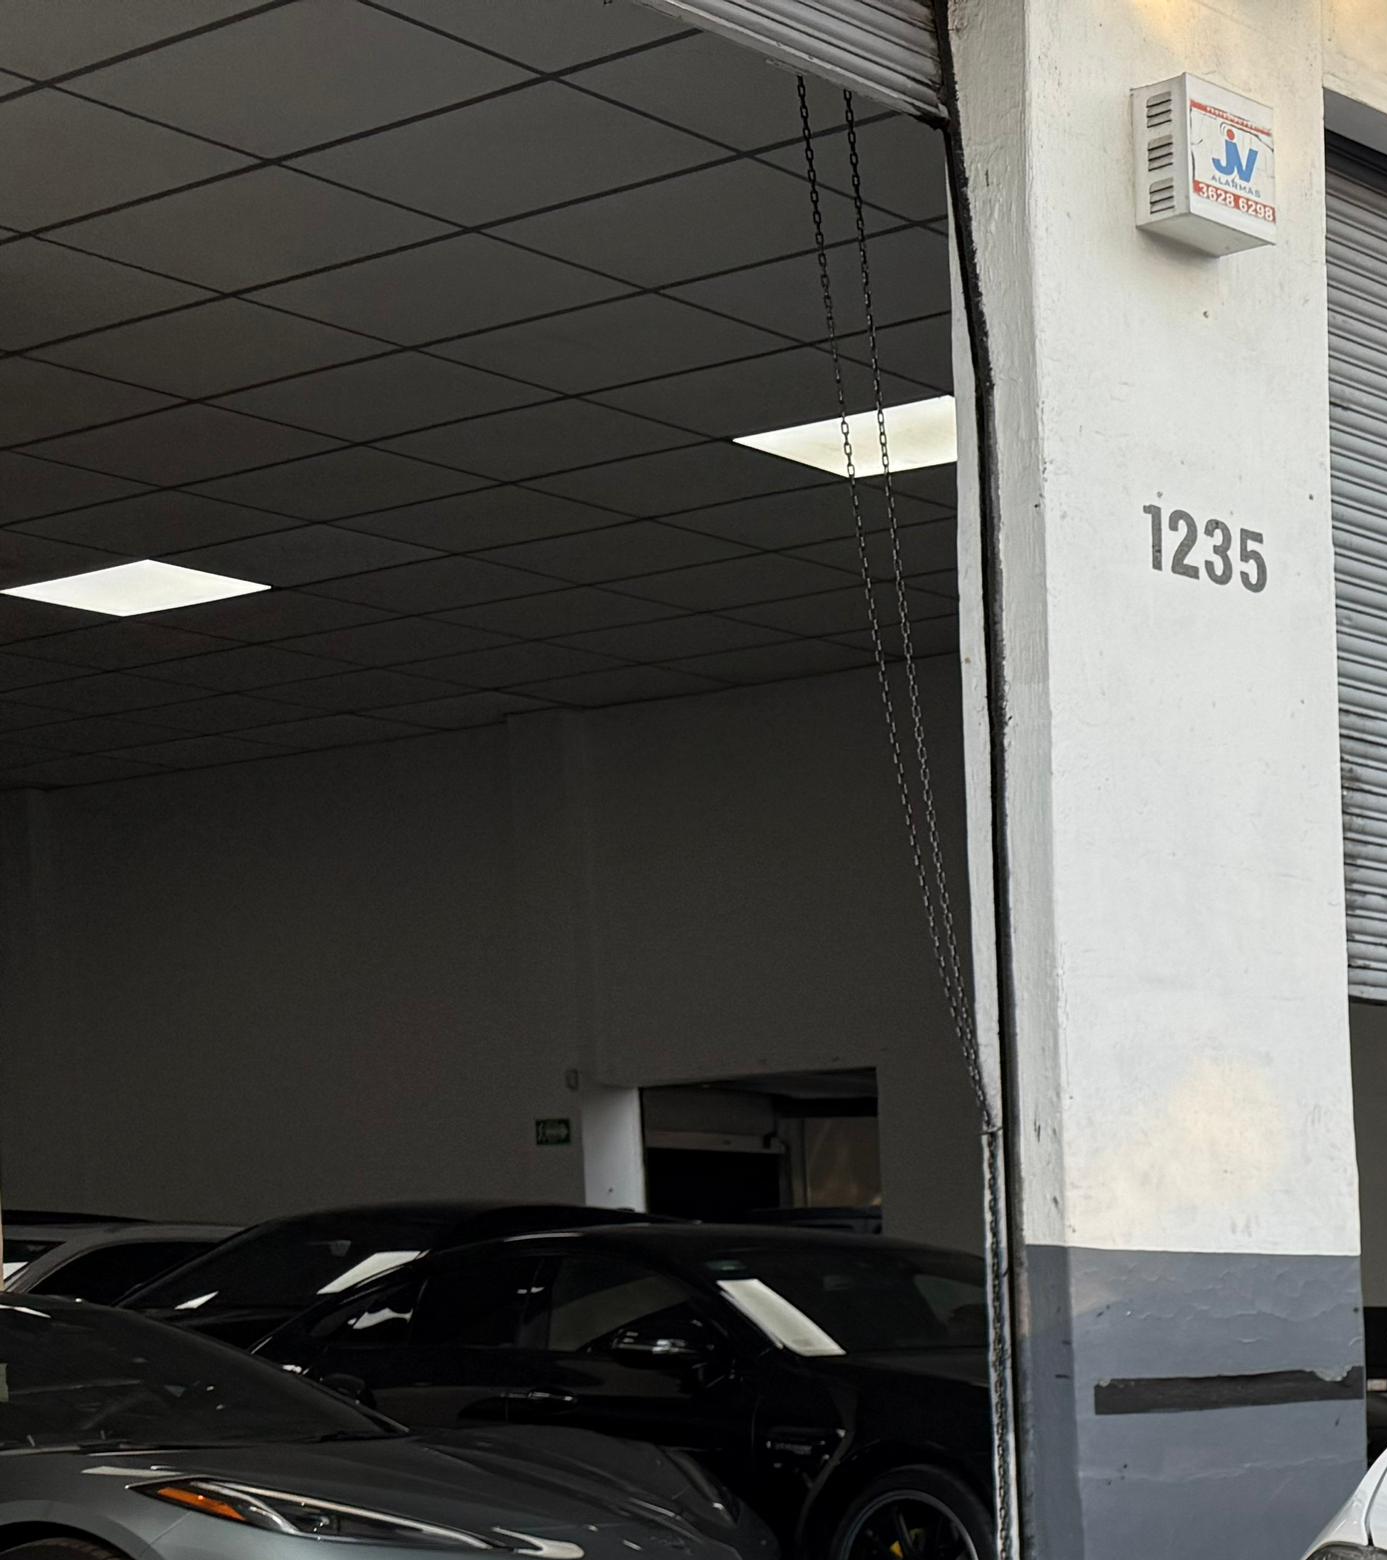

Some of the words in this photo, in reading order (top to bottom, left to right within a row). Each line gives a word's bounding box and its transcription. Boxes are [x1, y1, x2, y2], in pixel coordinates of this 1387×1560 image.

[1199, 183, 1235, 208] 3628
[1239, 197, 1274, 221] 6298
[1211, 175, 1262, 198] ALARMAS
[1143, 504, 1267, 593] 1235
